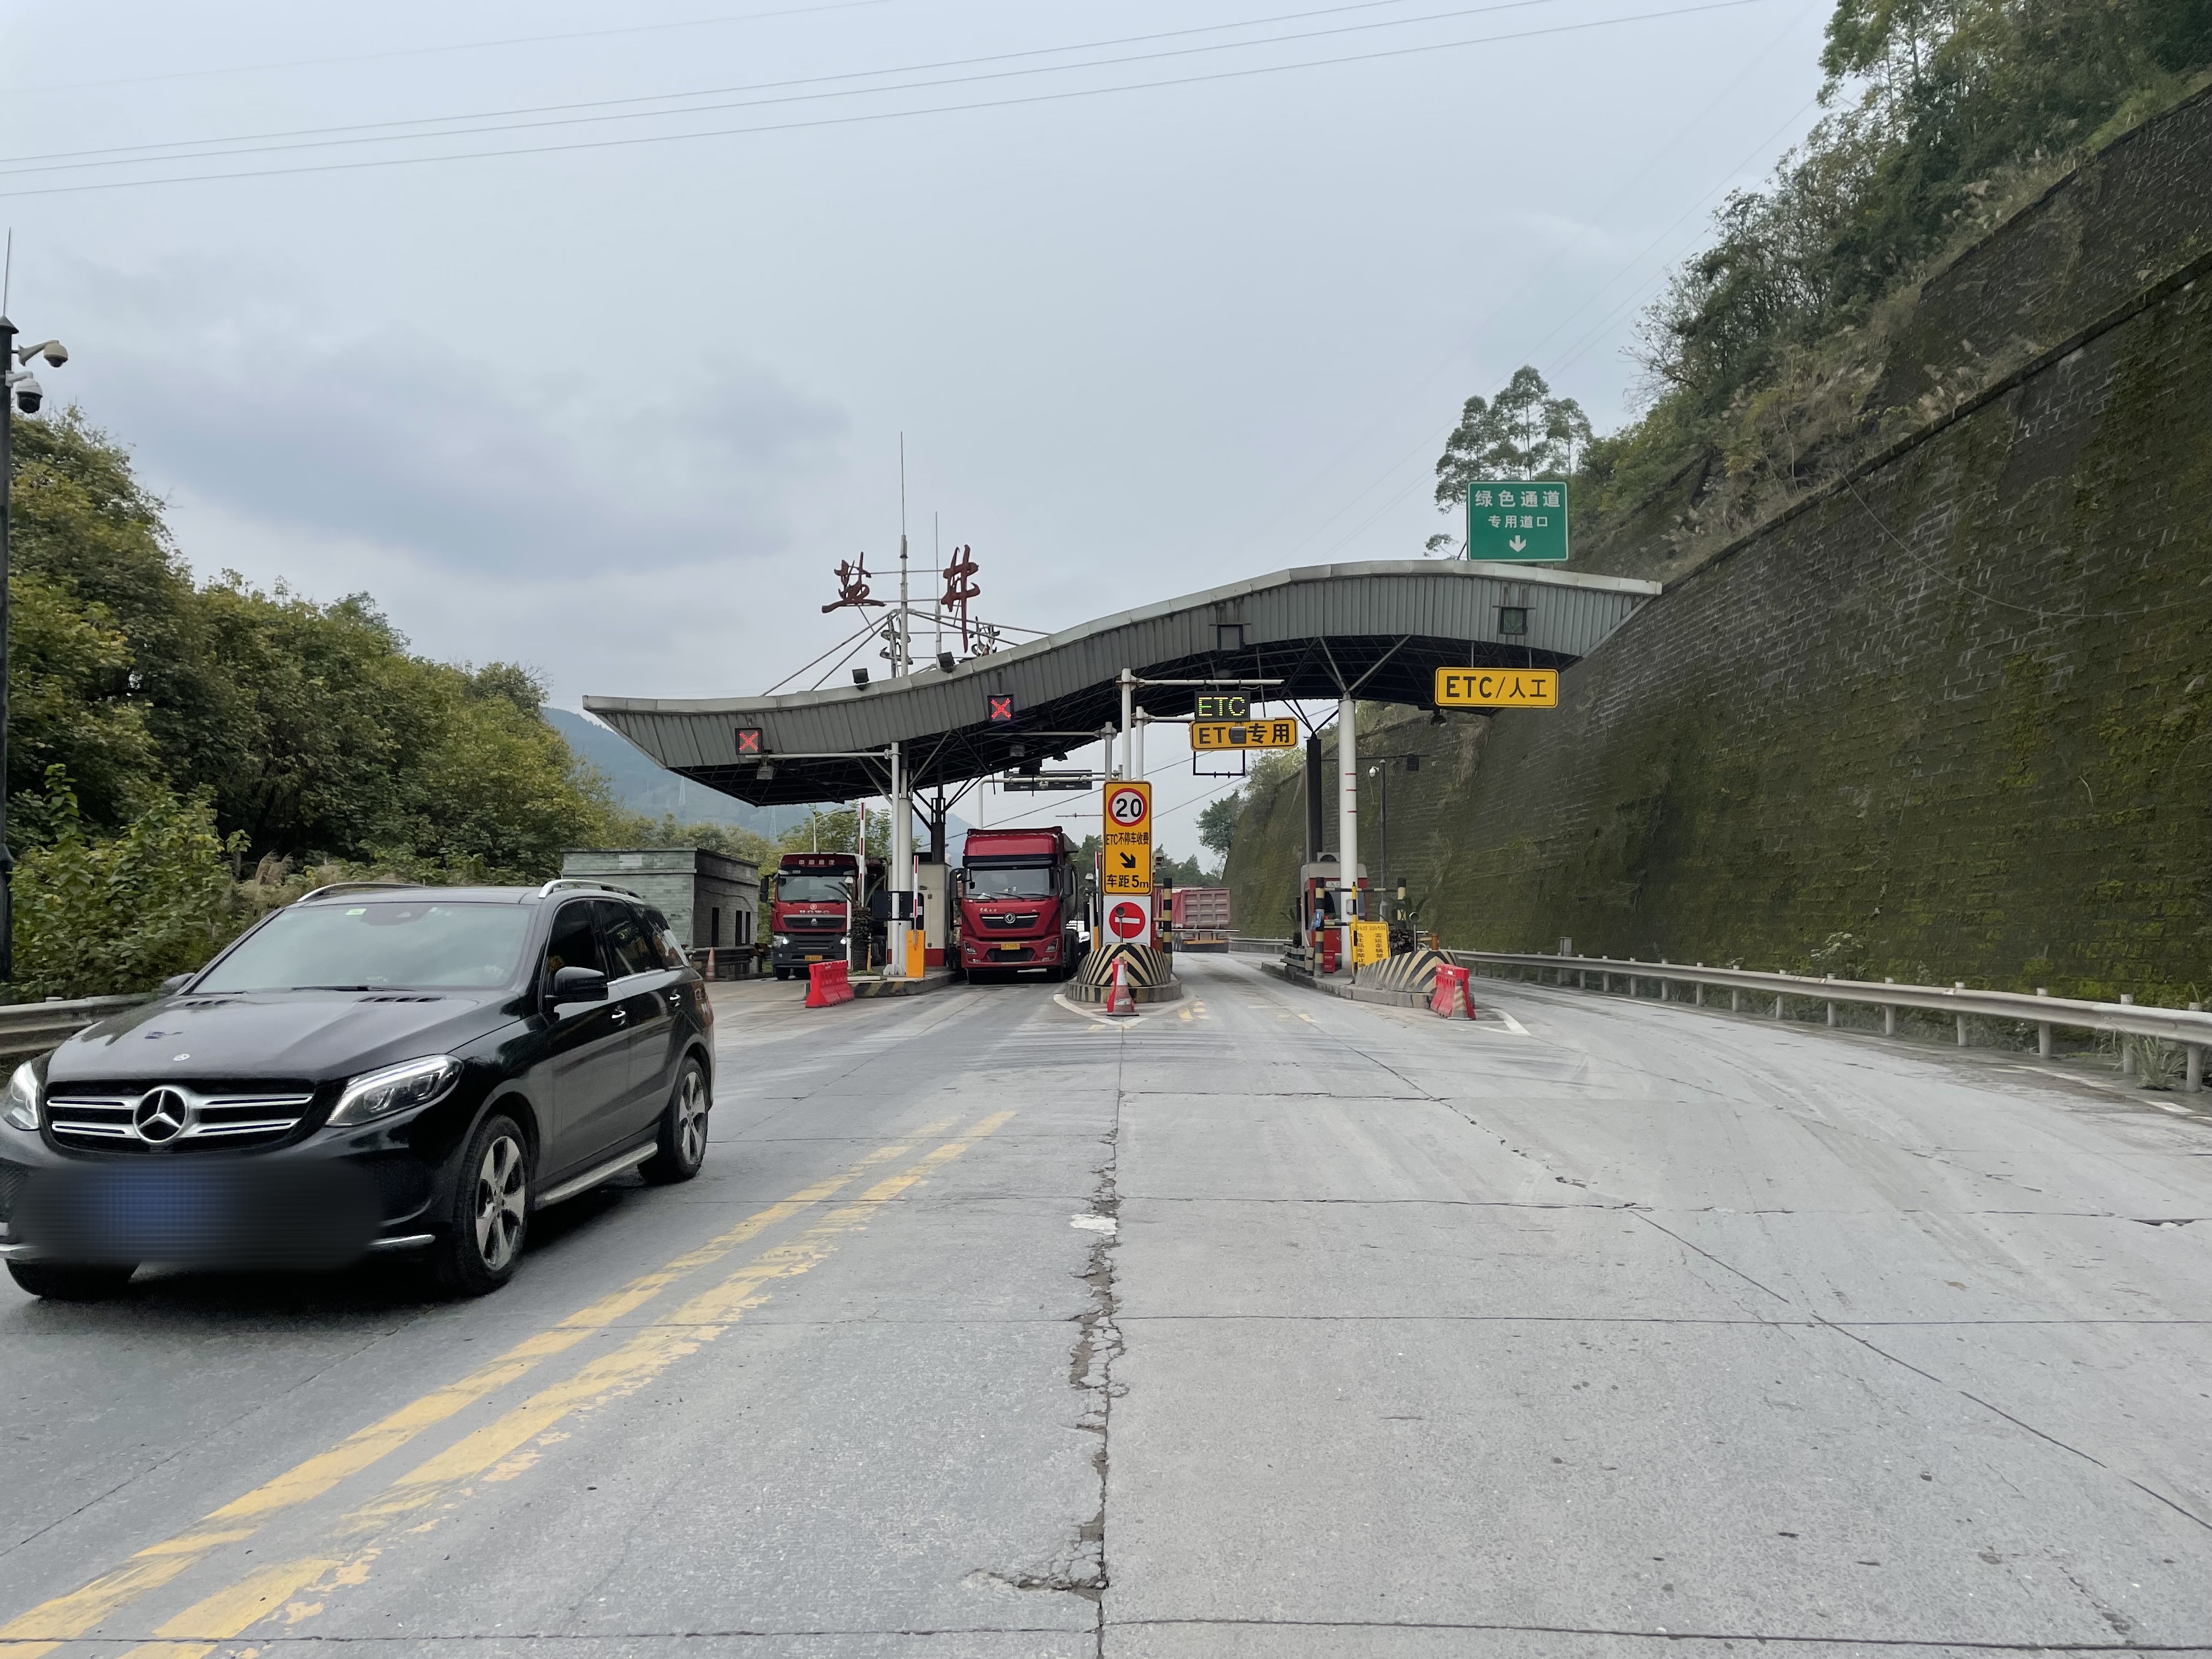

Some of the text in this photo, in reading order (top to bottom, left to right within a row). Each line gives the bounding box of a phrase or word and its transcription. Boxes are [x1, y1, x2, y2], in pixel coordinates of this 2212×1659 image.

[1475, 489, 1560, 507] 绿色通道
[1488, 515, 1548, 528] 专用道口
[1446, 675, 1547, 699] ETC/人工
[1199, 697, 1245, 716] ETC
[1199, 723, 1289, 744] ET专用
[1116, 798, 1142, 817] 20
[1106, 832, 1149, 845] ETC不停车收费
